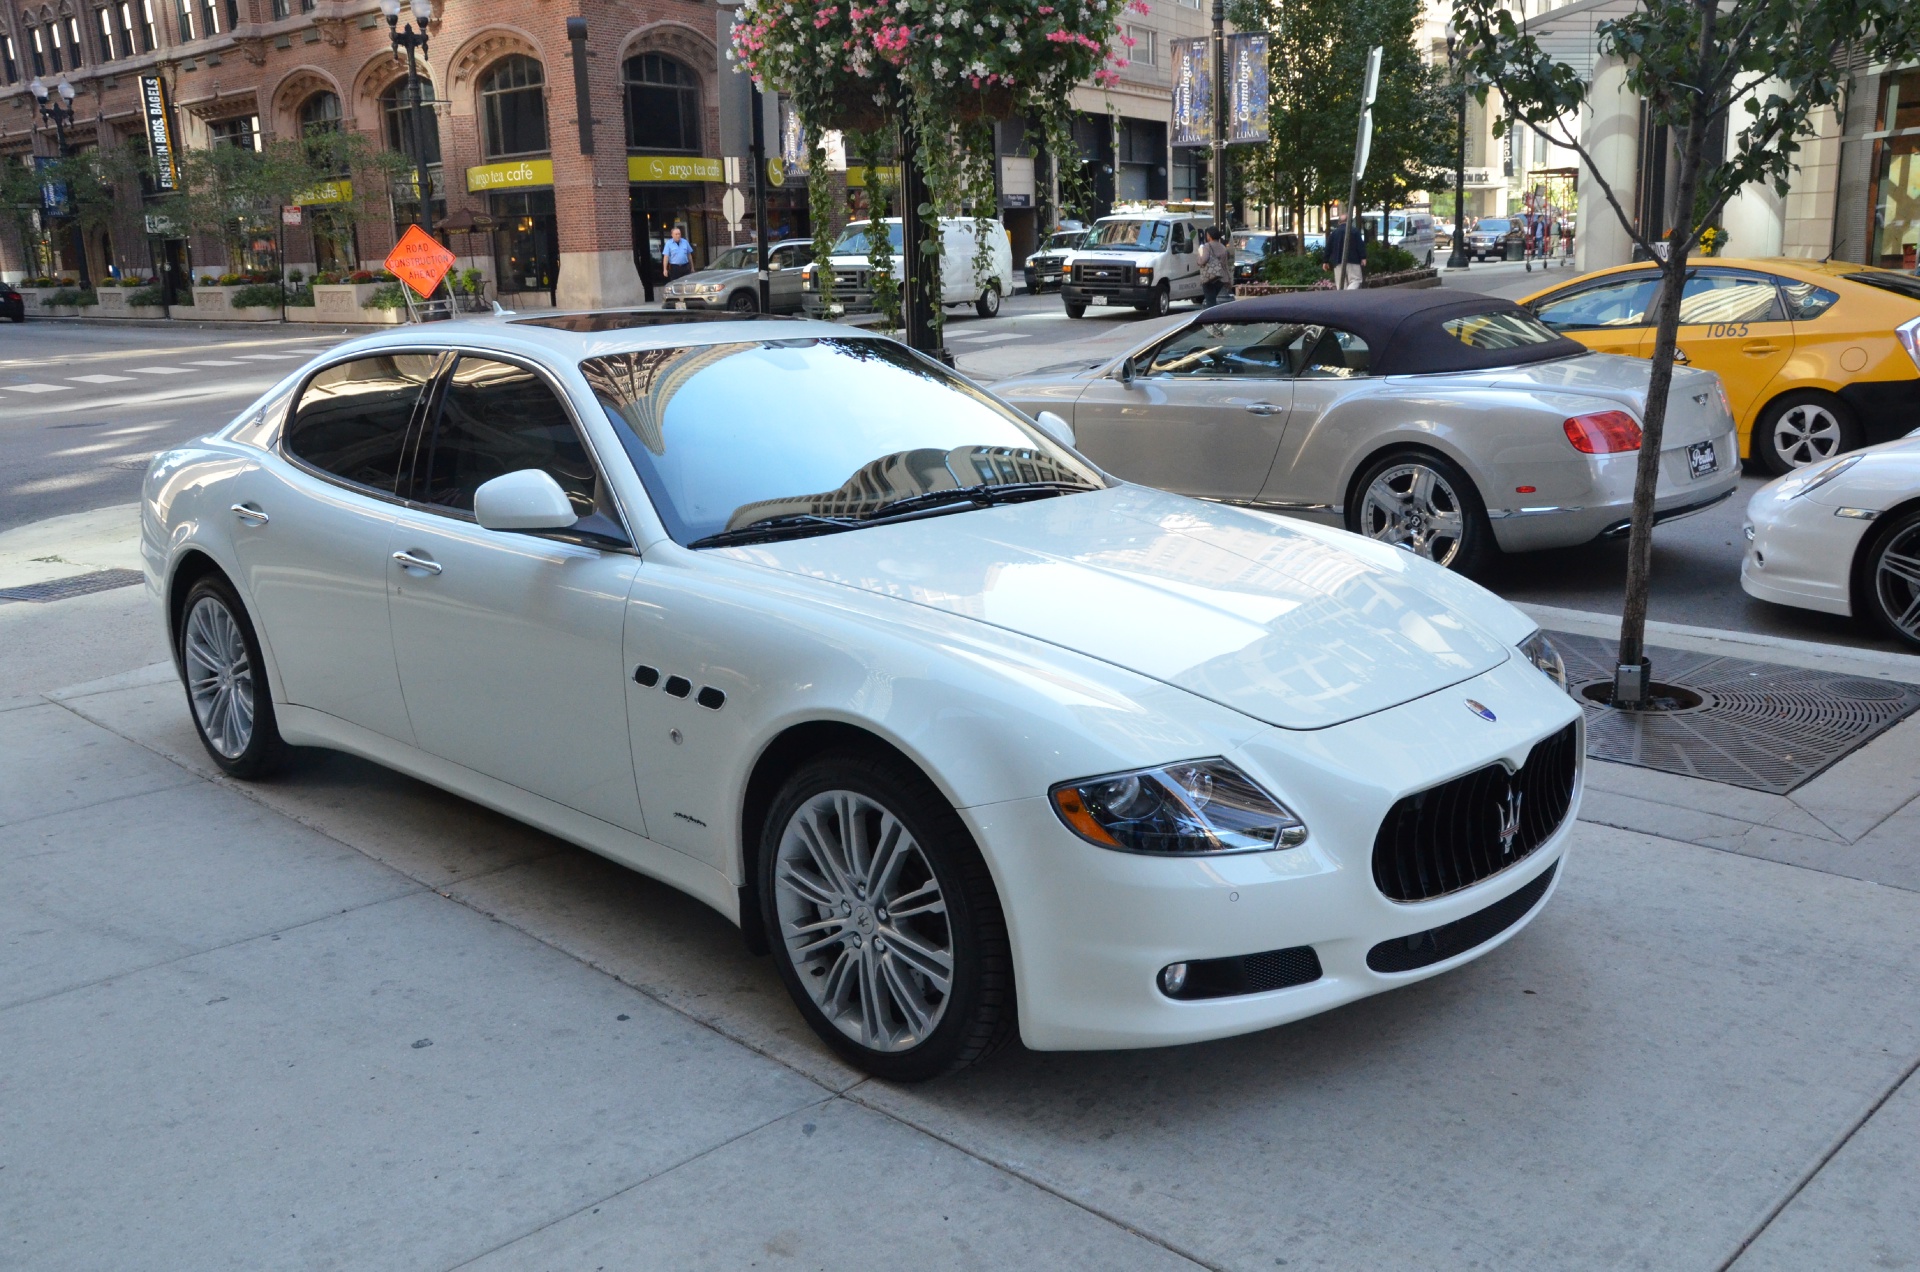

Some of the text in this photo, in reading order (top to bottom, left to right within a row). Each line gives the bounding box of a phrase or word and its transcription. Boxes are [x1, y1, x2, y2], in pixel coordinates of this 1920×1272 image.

[1181, 55, 1192, 125] Cosmologies
[1239, 50, 1252, 121] Cosmologies
[146, 79, 162, 115] BAGELS
[788, 111, 797, 163] Cosmologies
[1236, 130, 1259, 139] LUMA
[491, 171, 504, 183] tea
[507, 162, 533, 181] café
[669, 164, 692, 179] argo
[694, 163, 706, 176] tea
[405, 242, 429, 254] ROAD
[389, 254, 449, 269] CONSTRUCTION
[409, 268, 436, 280] AHEAD
[1707, 321, 1749, 338] 1065
